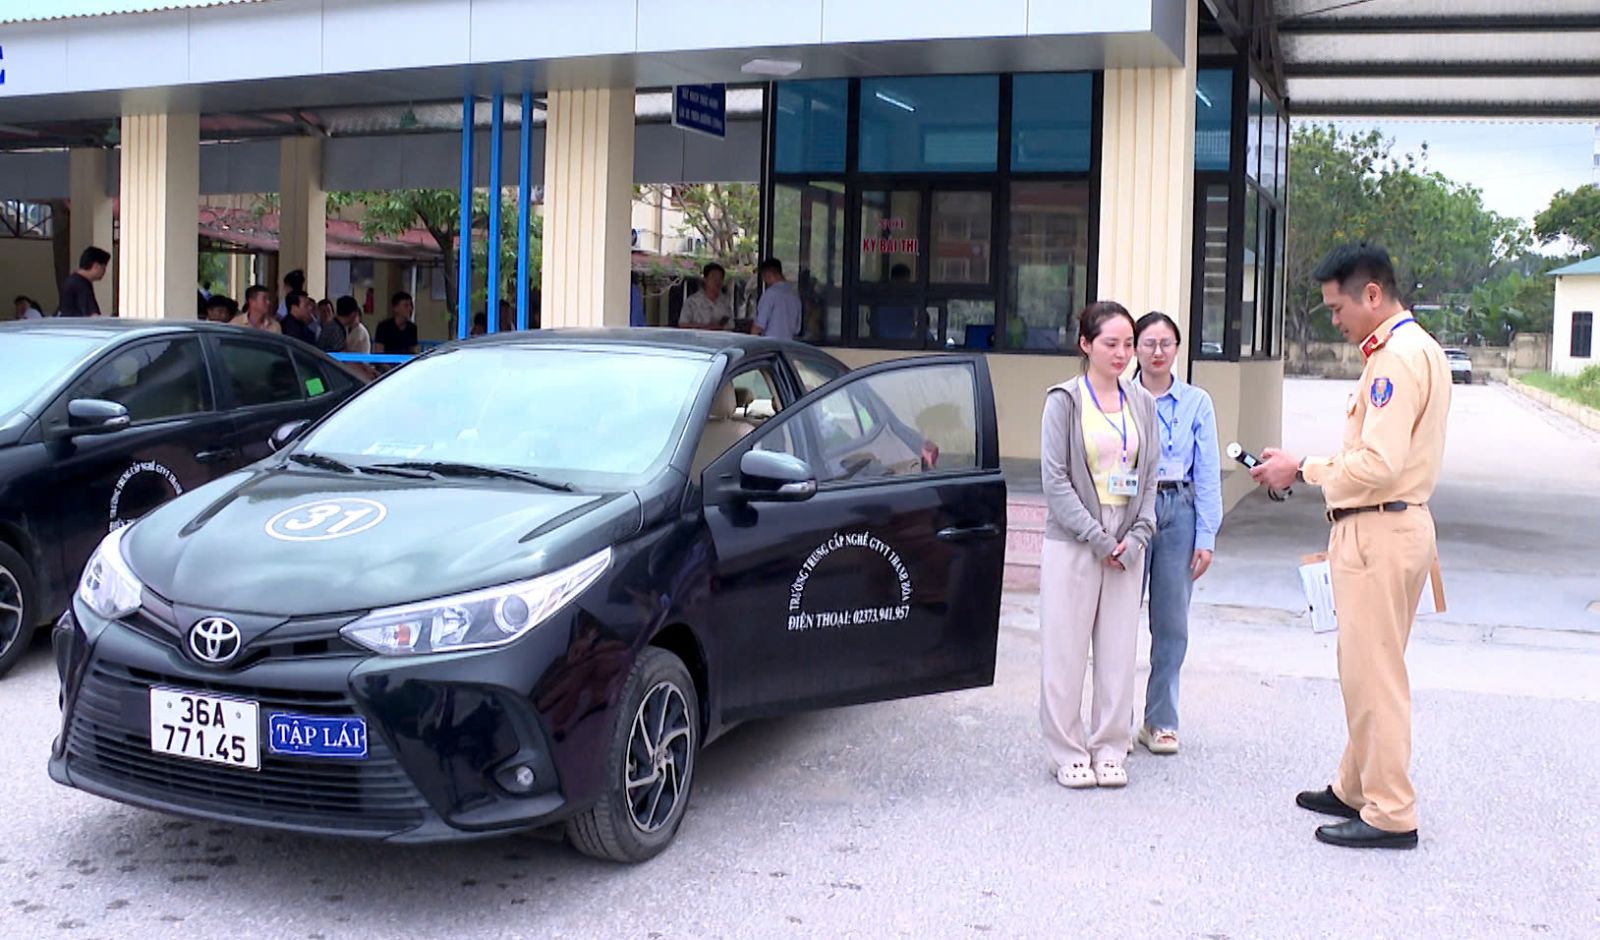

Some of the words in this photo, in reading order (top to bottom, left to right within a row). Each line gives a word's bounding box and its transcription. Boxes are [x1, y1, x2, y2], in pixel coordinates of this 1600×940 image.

[284, 504, 373, 533] 31
[869, 537, 891, 556] GTVT
[788, 611, 814, 632] ĐIỆN
[815, 610, 851, 628] THOẠI:
[181, 696, 226, 729] 36A
[162, 724, 246, 763] 771.45
[276, 720, 317, 749] TẬP
[322, 722, 361, 749] LÁI
